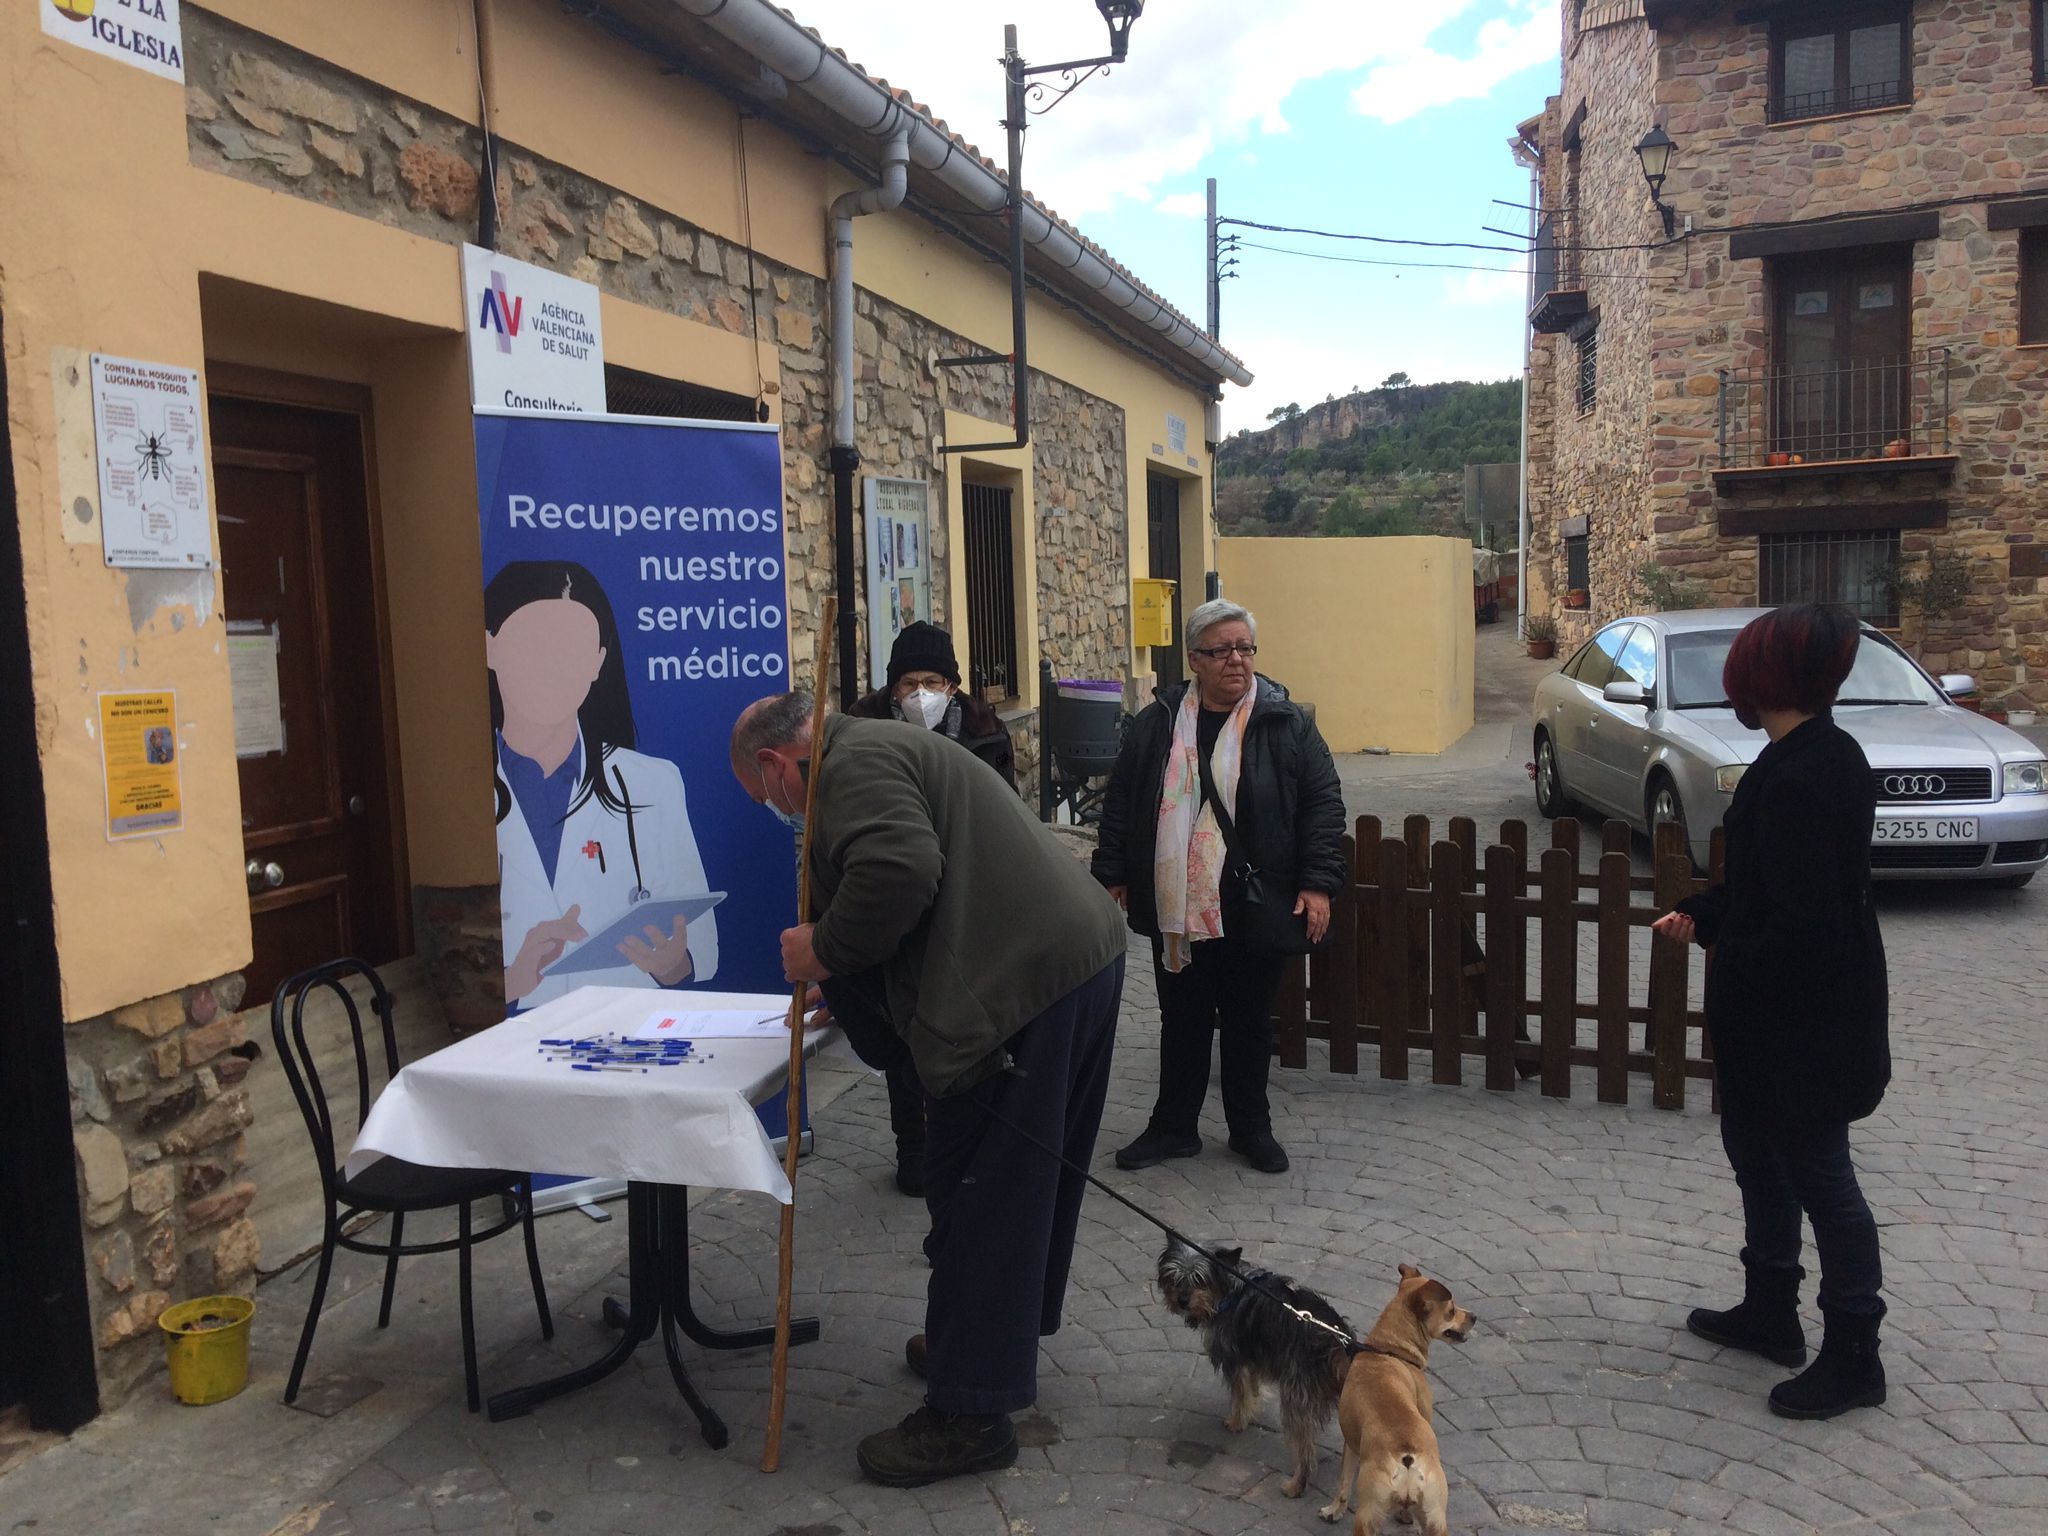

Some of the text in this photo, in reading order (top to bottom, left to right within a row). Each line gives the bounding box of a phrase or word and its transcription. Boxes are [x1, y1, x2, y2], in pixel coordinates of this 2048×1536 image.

[91, 15, 181, 69] IGLESIA
[532, 317, 596, 347] VALENCIANA
[542, 338, 589, 361] DE SALUT
[104, 363, 188, 384] CONTRA EL MOSQUITO
[104, 374, 156, 390] LUCHAMOS
[508, 494, 778, 537] Recuperemos
[640, 551, 780, 581] nuestro
[637, 598, 782, 632] servicio
[648, 647, 784, 681] médico
[1876, 820, 1974, 839] 5255 CNC
